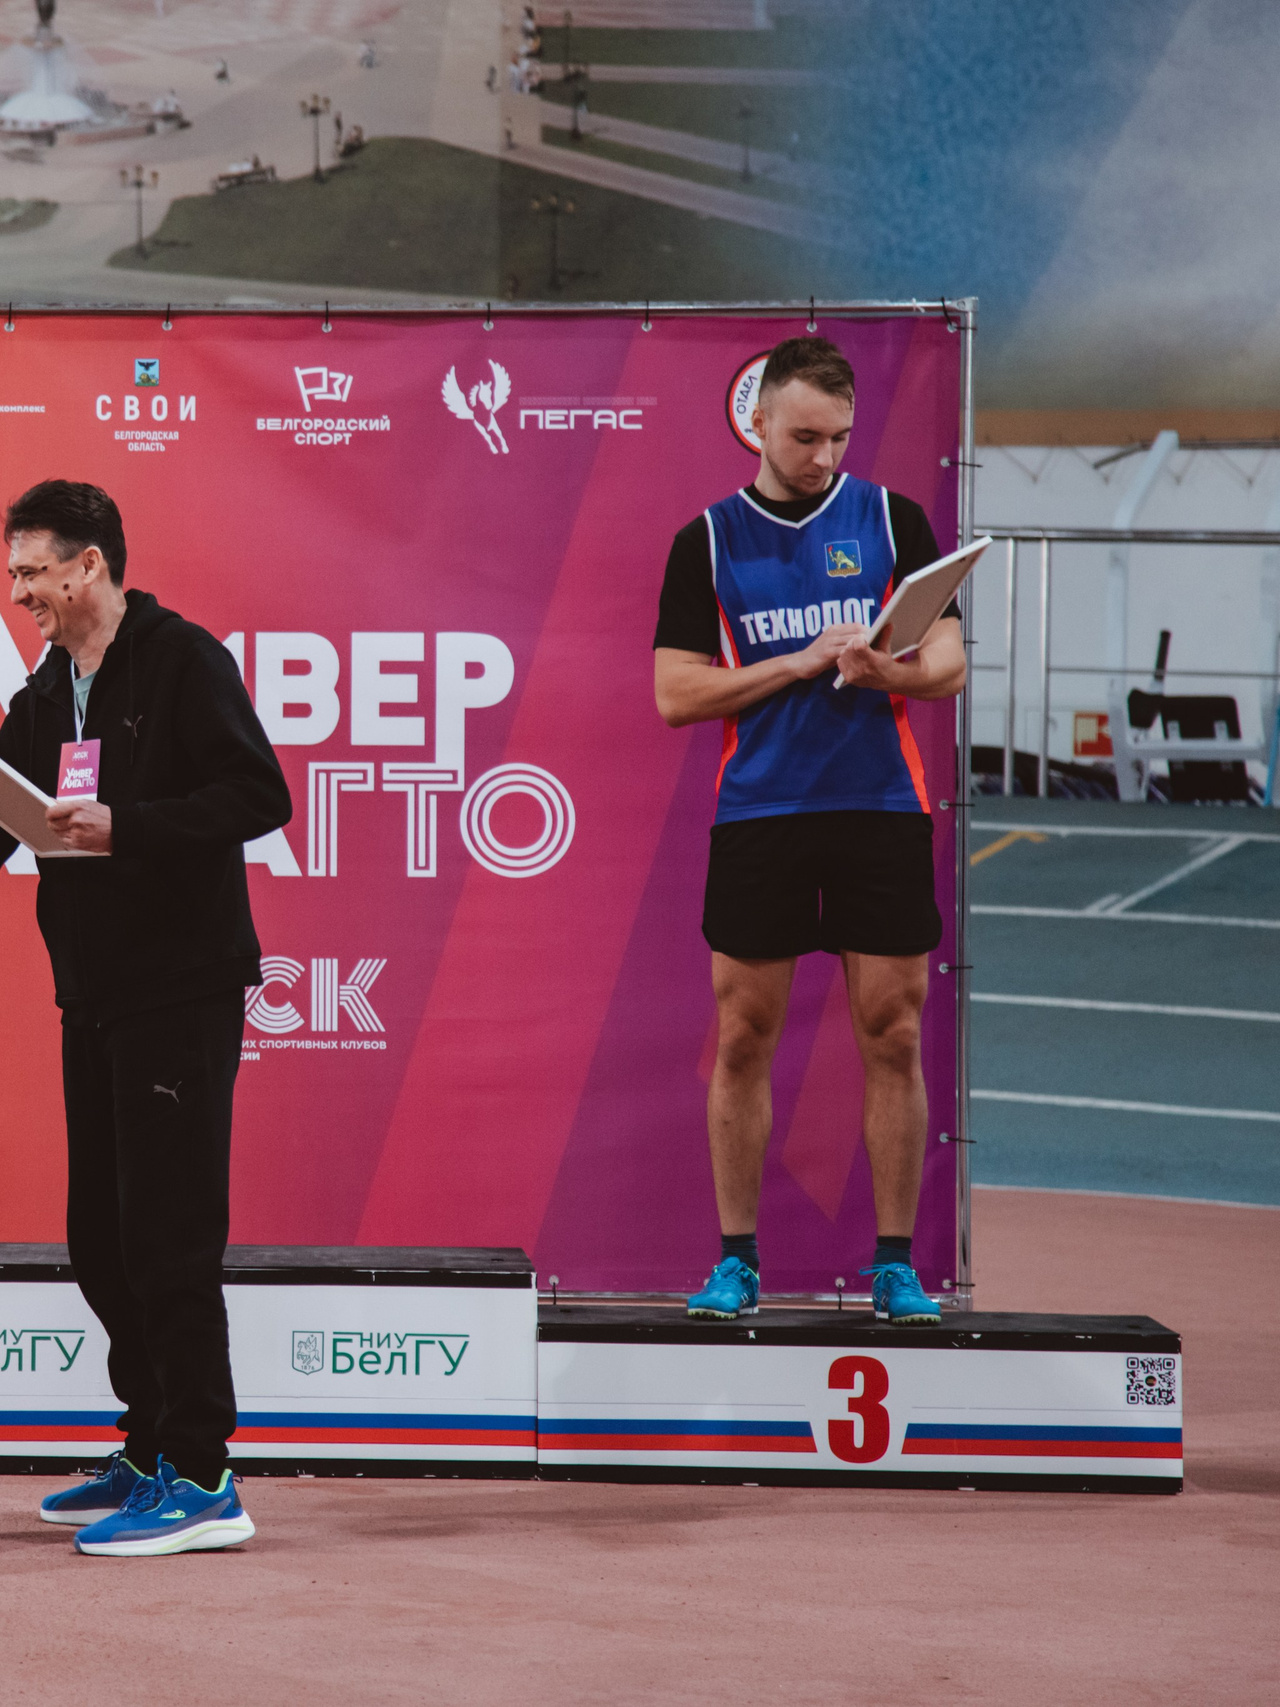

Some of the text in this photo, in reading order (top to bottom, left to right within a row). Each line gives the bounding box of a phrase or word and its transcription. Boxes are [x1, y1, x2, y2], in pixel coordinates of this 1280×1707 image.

[95, 394, 197, 421] СВОИ
[256, 415, 390, 431] БЕЛГОРОДСКИЙ
[519, 409, 643, 430] ПЕГАС
[114, 430, 179, 441] БЕЛГОРОДСКАЯ
[294, 432, 352, 446] СПОРТ
[128, 442, 166, 452] ОБЛАСТЬ
[259, 1040, 338, 1049] СПОРТИВНЫХ
[340, 1040, 387, 1050] КЛУБОВ
[359, 1332, 407, 1349] НИУ
[332, 1338, 470, 1376] БелГУ
[827, 1355, 890, 1464] 3
